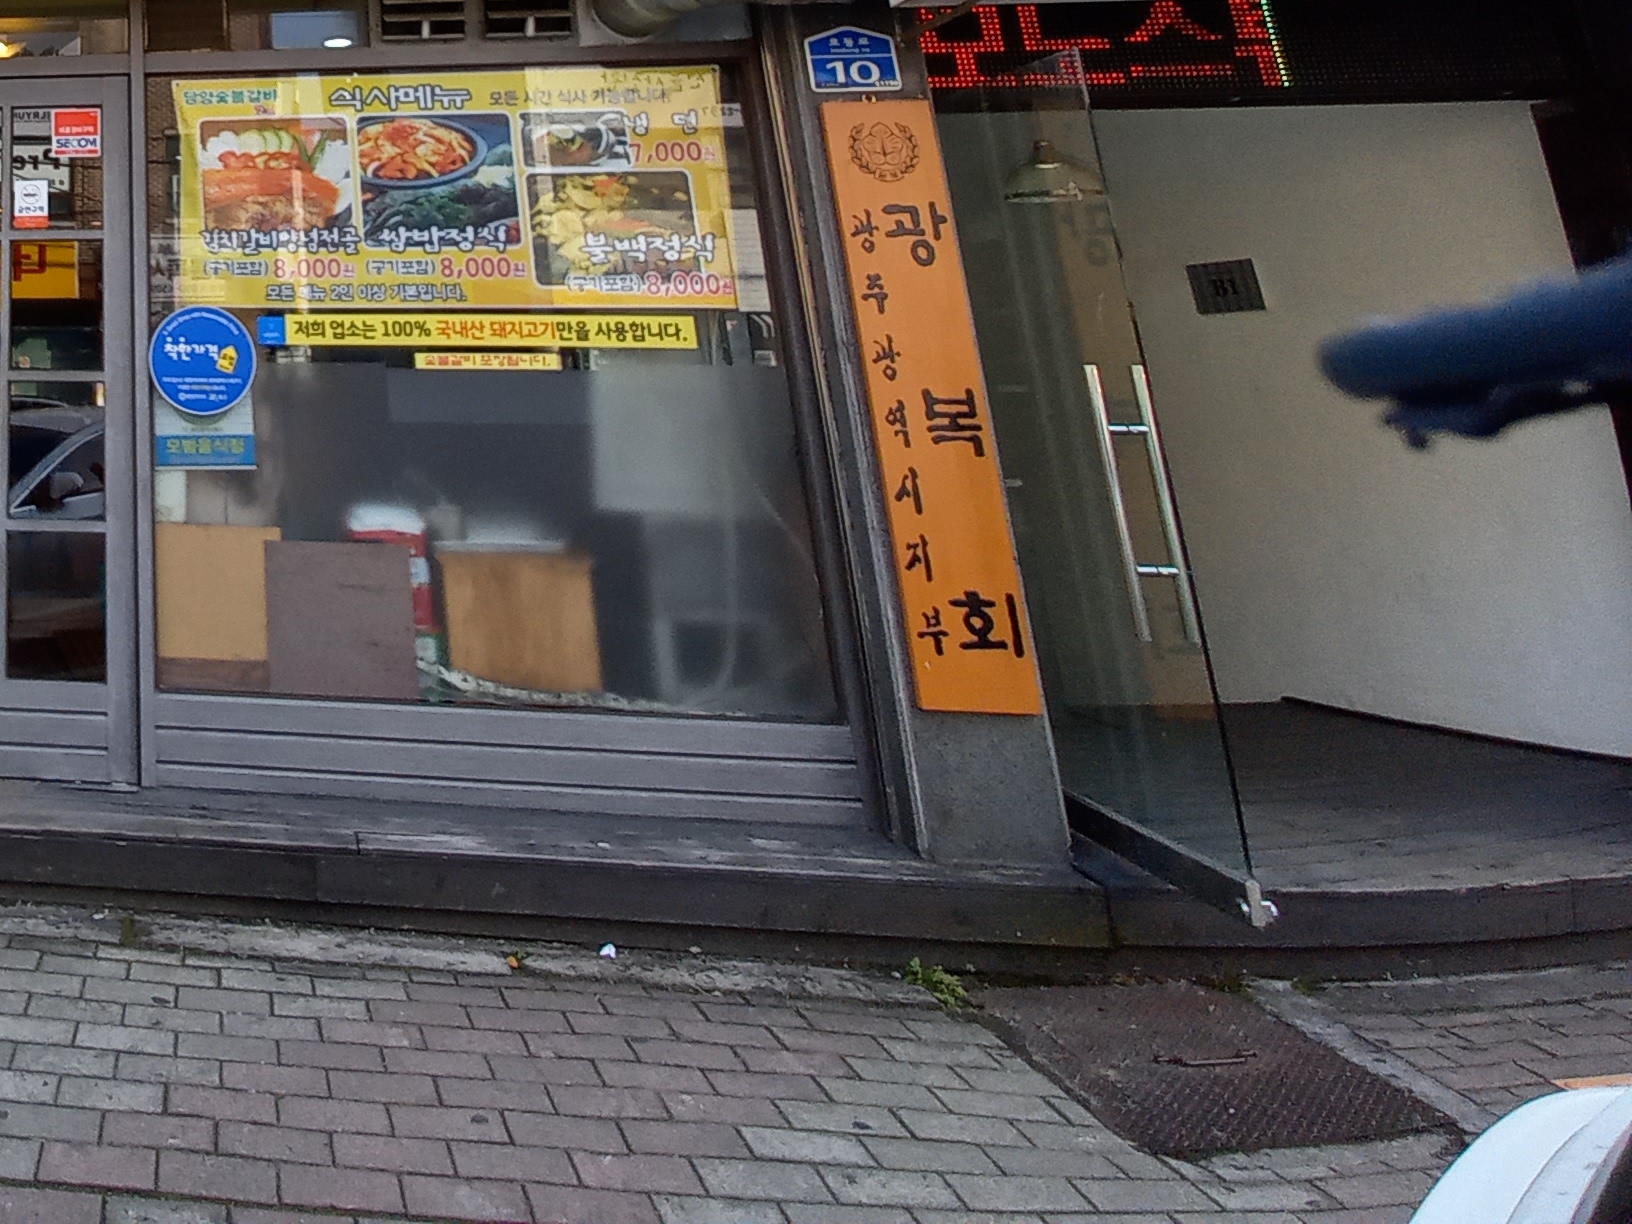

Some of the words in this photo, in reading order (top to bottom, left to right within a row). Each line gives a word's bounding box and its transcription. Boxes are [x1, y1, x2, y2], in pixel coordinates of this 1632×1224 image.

[825, 60, 881, 84] 10
[328, 84, 472, 111] 식사메뉴
[489, 89, 519, 107] 모든
[556, 87, 589, 104] 식사
[378, 225, 509, 254] 쌈밥정식
[581, 231, 718, 264] 불백정식
[266, 284, 295, 301] 모든
[329, 283, 355, 301] 2인
[358, 283, 388, 301] 이상
[294, 319, 327, 339] 저희
[329, 319, 378, 340] 업소는
[380, 319, 432, 338] 100%
[434, 319, 486, 341] 국내산
[595, 320, 689, 343] 사용합니다.
